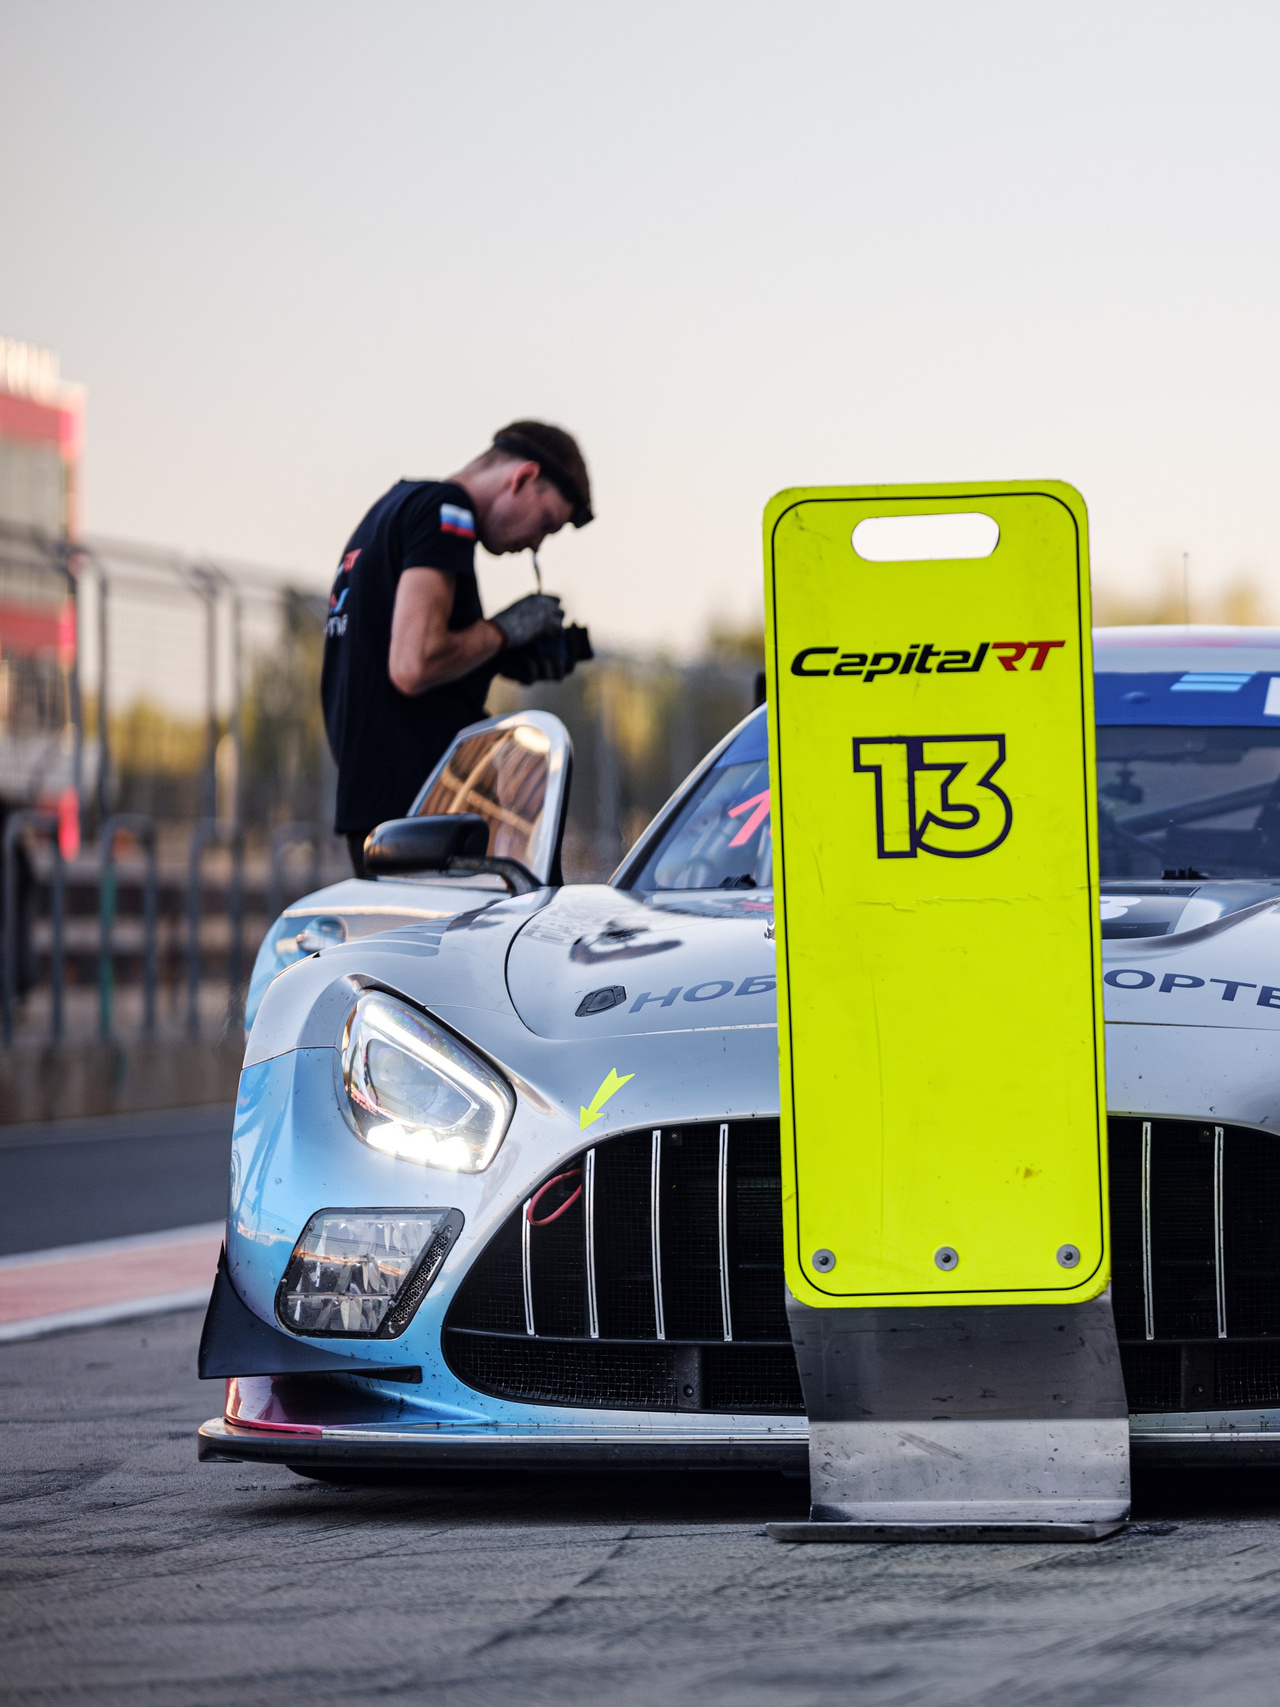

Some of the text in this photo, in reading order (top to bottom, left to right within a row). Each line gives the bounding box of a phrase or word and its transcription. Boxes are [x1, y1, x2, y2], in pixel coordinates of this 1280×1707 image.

[790, 640, 1066, 683] CapitalRT
[728, 788, 772, 849] 1
[852, 733, 1013, 859] 13
[628, 974, 777, 1014] НОБ
